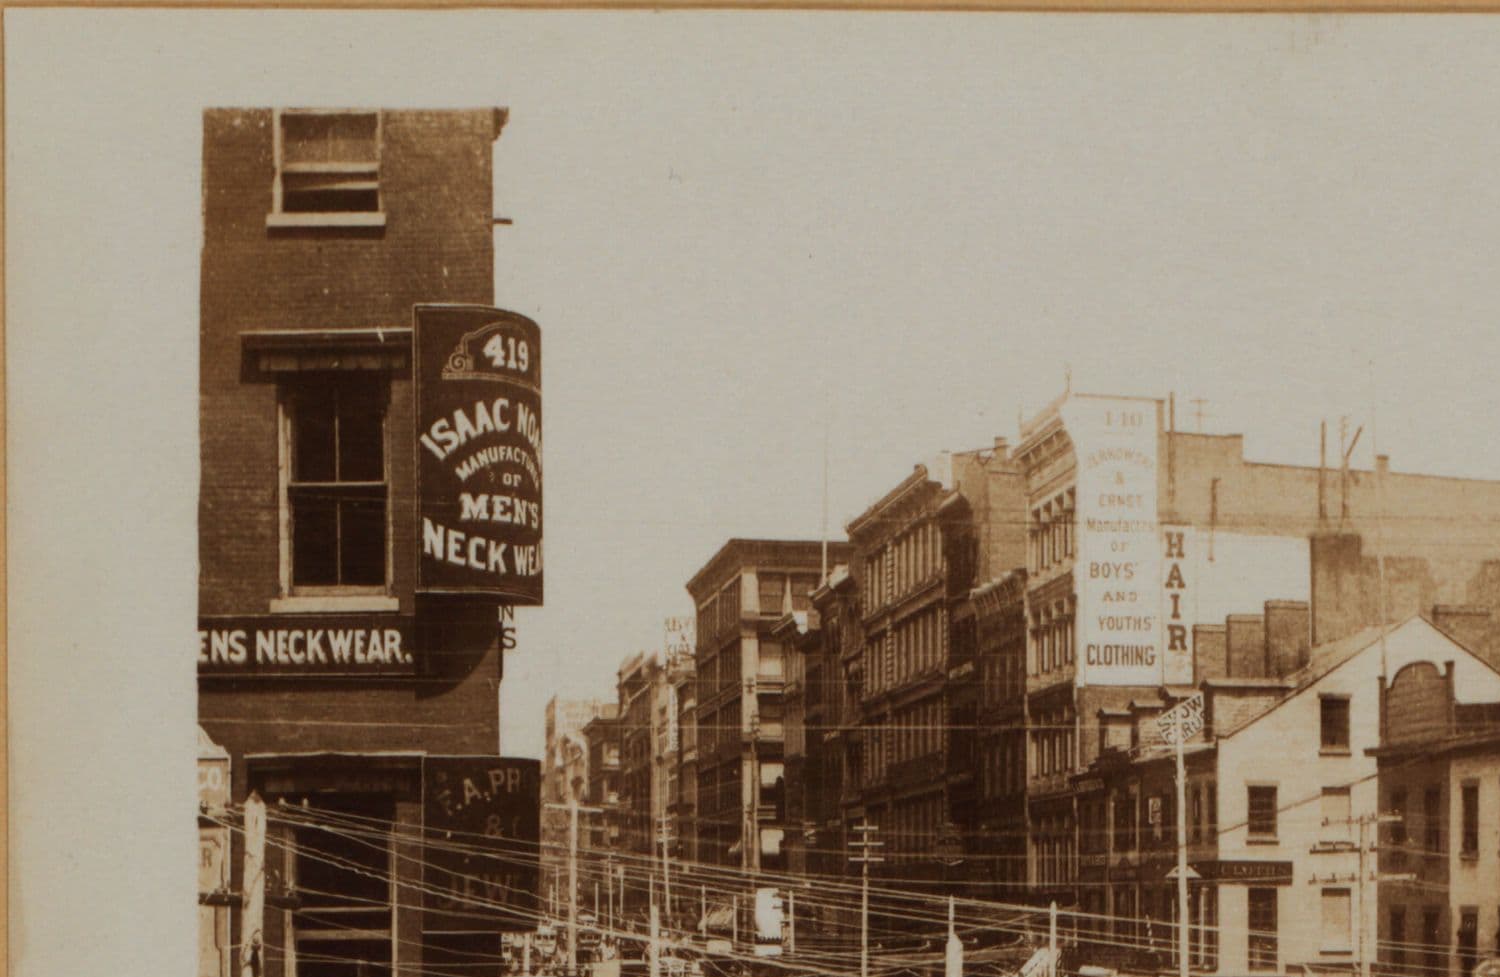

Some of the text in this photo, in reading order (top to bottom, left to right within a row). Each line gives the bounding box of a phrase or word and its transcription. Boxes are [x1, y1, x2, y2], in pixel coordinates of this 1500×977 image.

[482, 333, 529, 372] 419
[420, 397, 511, 460] ISAAC
[502, 472, 522, 487] OF
[460, 492, 539, 530] MEN'S
[423, 516, 507, 574] NECK
[1103, 591, 1138, 602] AND
[1086, 644, 1155, 667] CLOTHING
